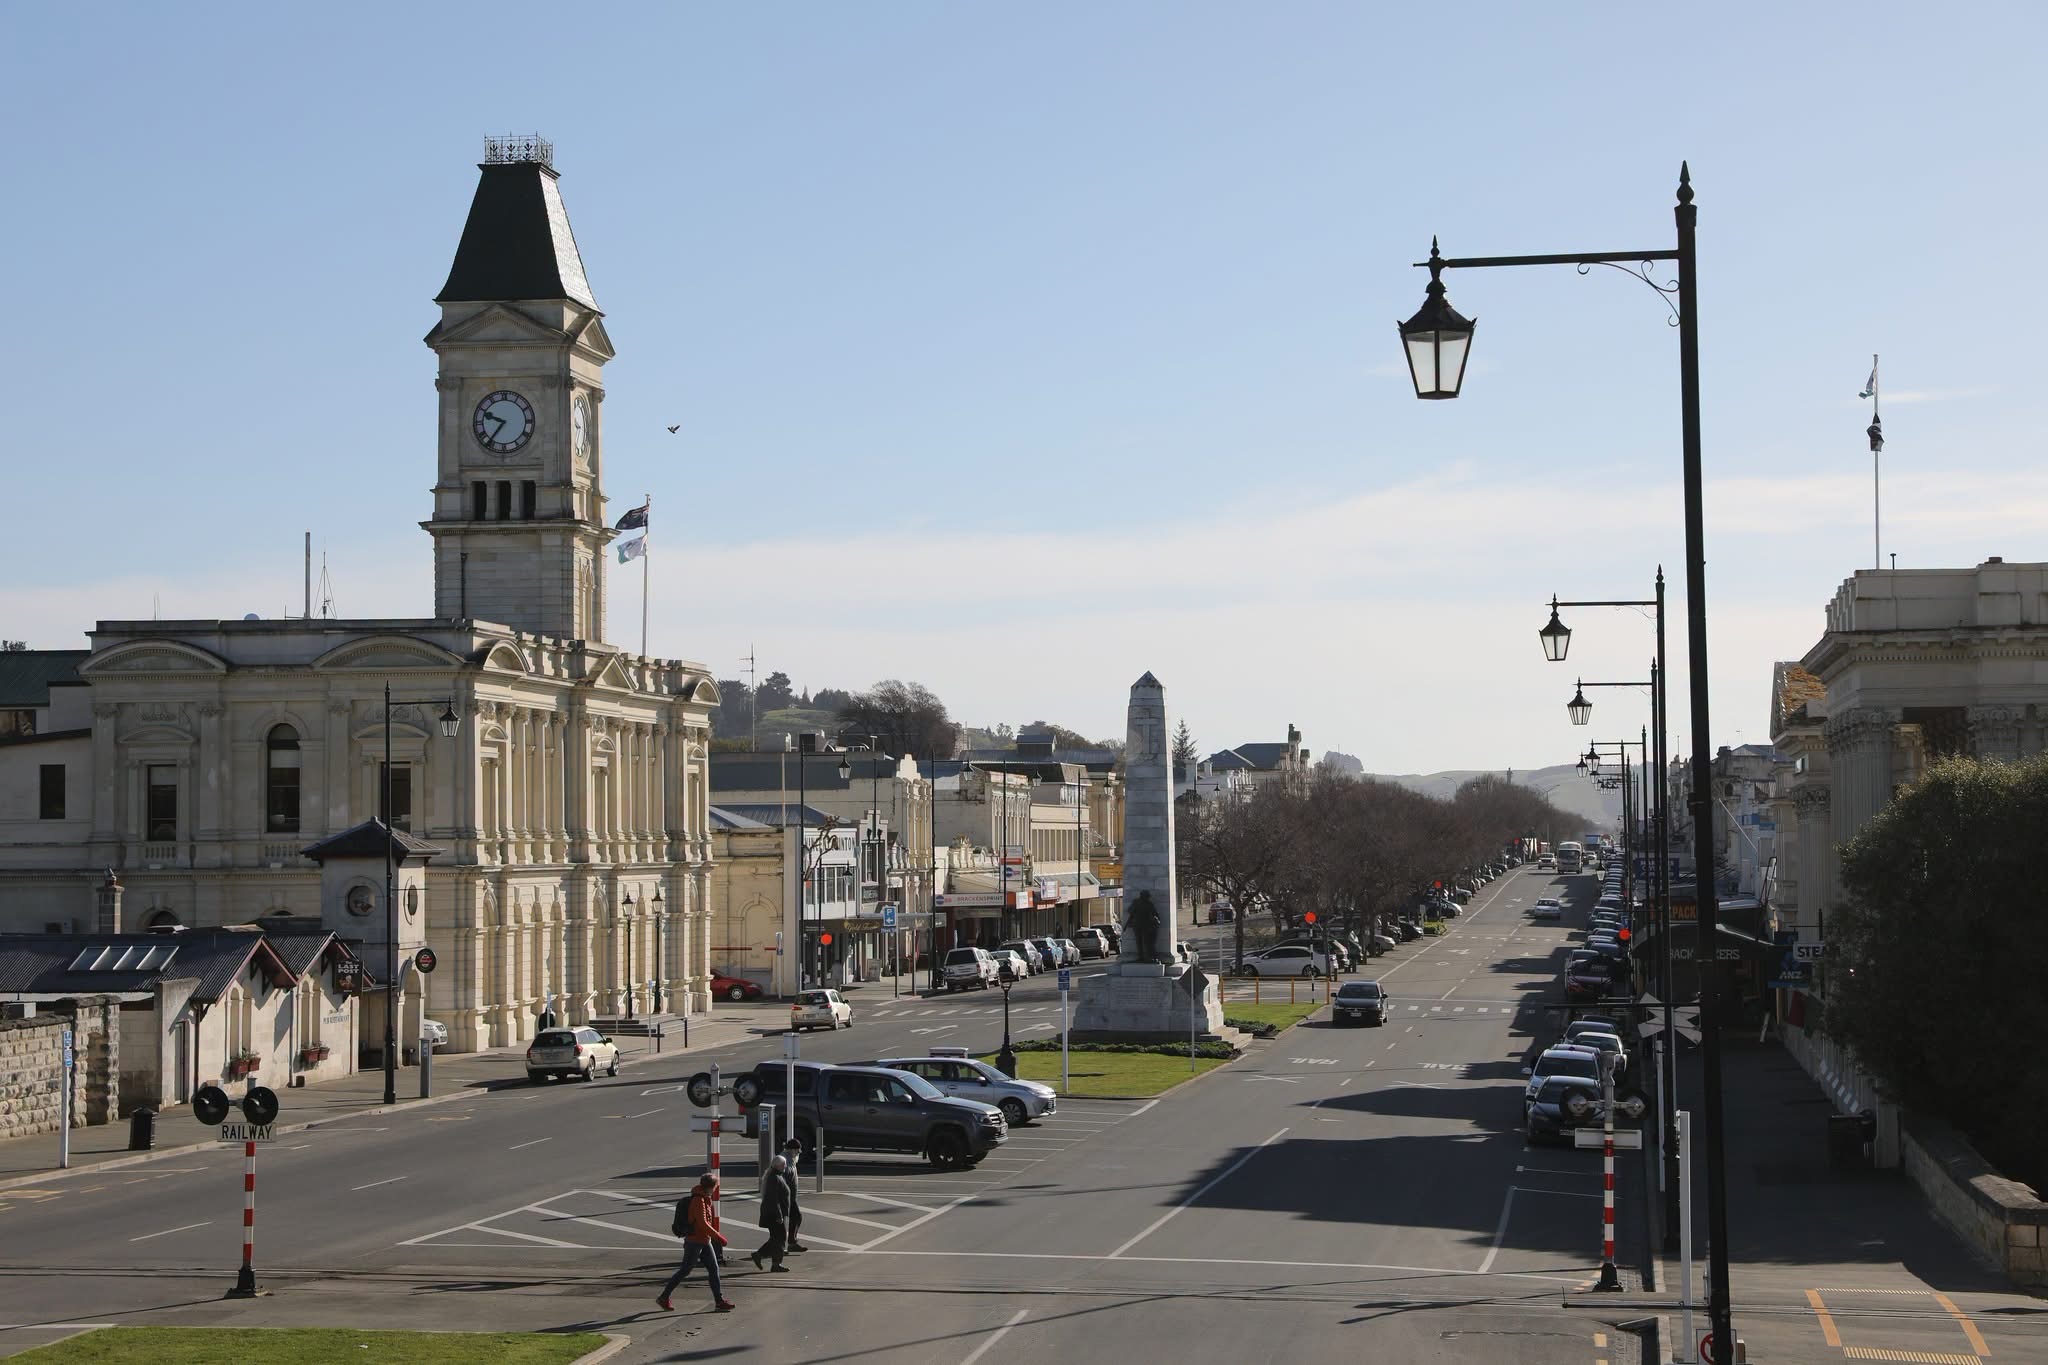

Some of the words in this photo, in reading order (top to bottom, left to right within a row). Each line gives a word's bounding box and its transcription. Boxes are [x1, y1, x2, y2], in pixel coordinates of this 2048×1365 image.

[886, 908, 893, 916] P
[1779, 970, 1802, 979] ANZ
[221, 1124, 272, 1139] RAILWAY
